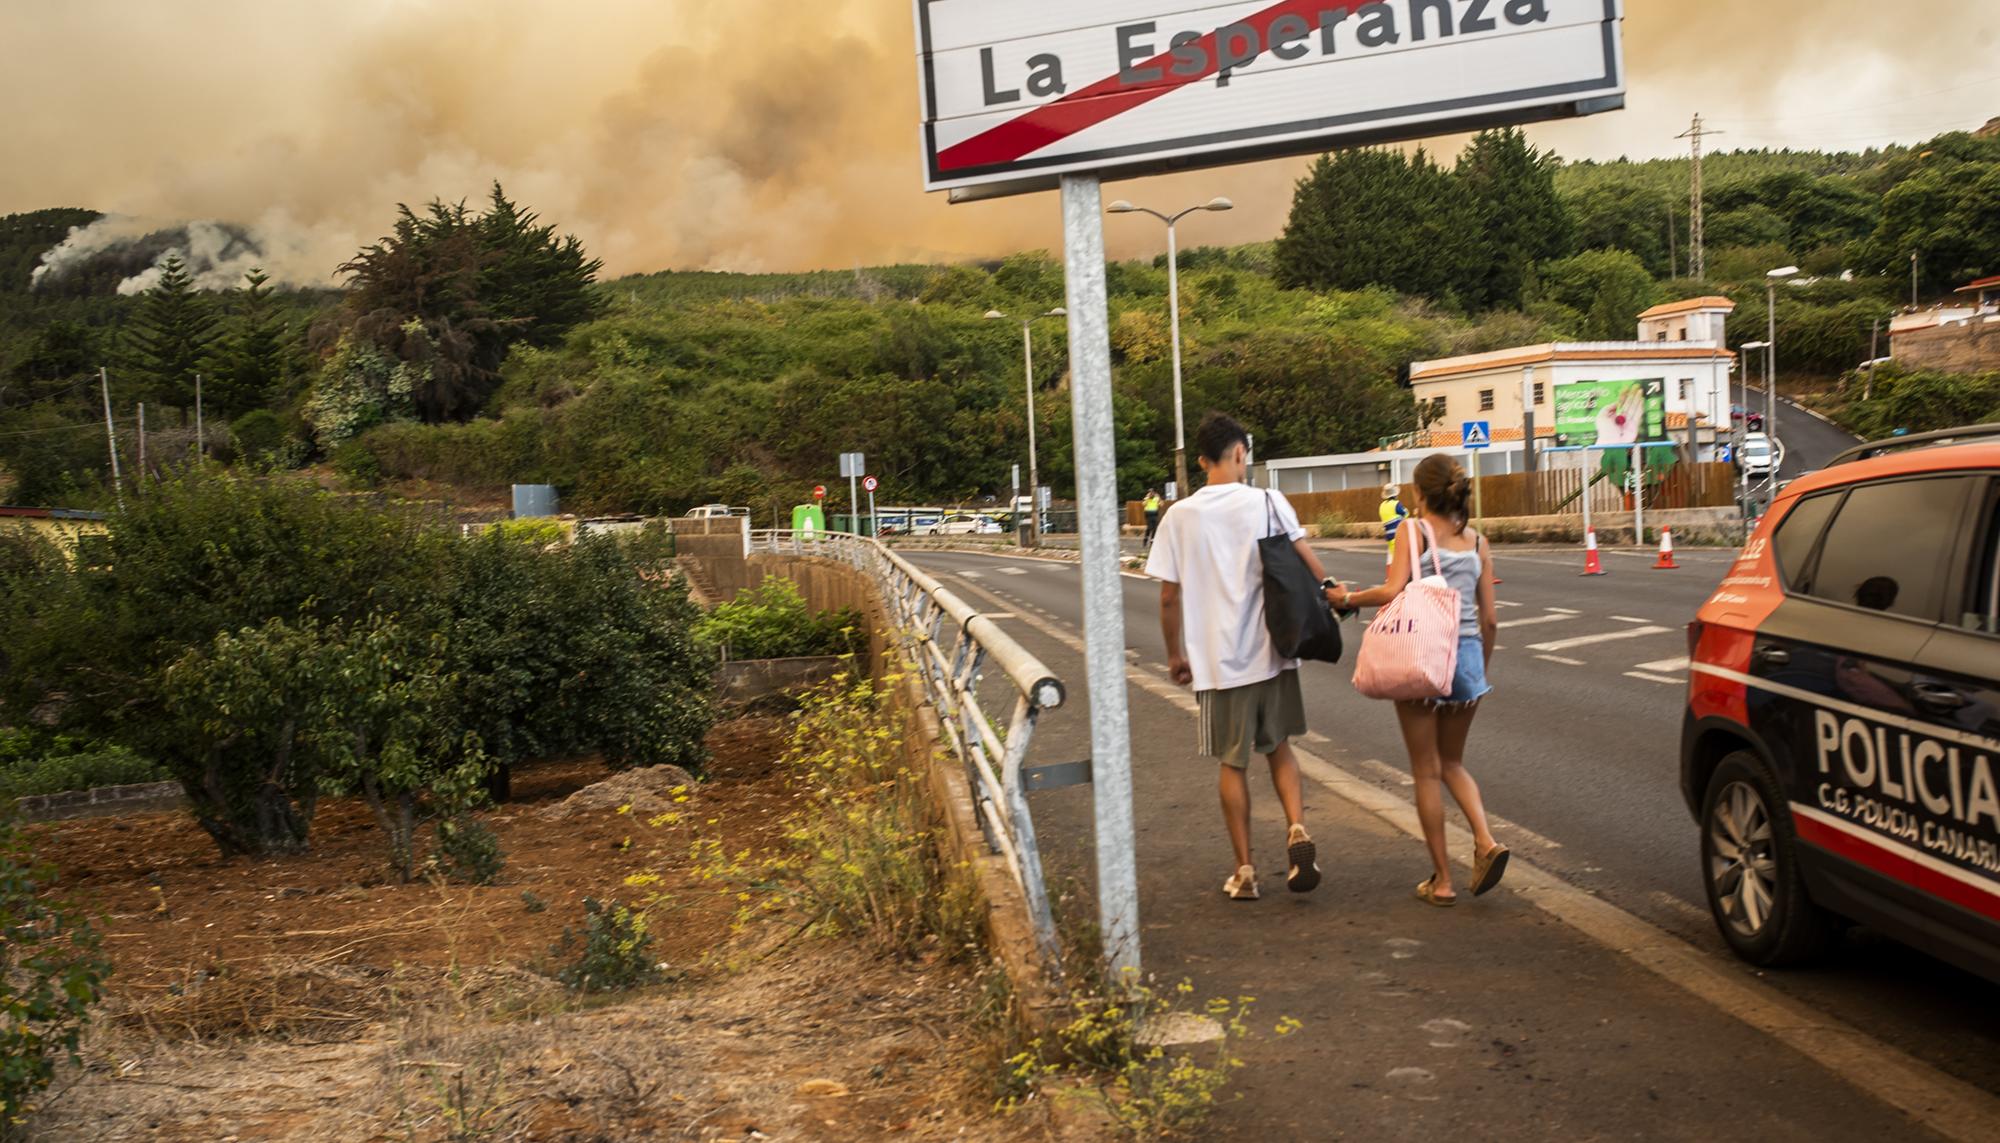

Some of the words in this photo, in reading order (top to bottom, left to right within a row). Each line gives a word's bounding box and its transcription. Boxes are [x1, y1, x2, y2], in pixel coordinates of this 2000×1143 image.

[978, 46, 1066, 106] La
[1115, 0, 1550, 88] Esperanza
[1815, 709, 2000, 834] POLICIA
[1852, 794, 1920, 843] POLICIA
